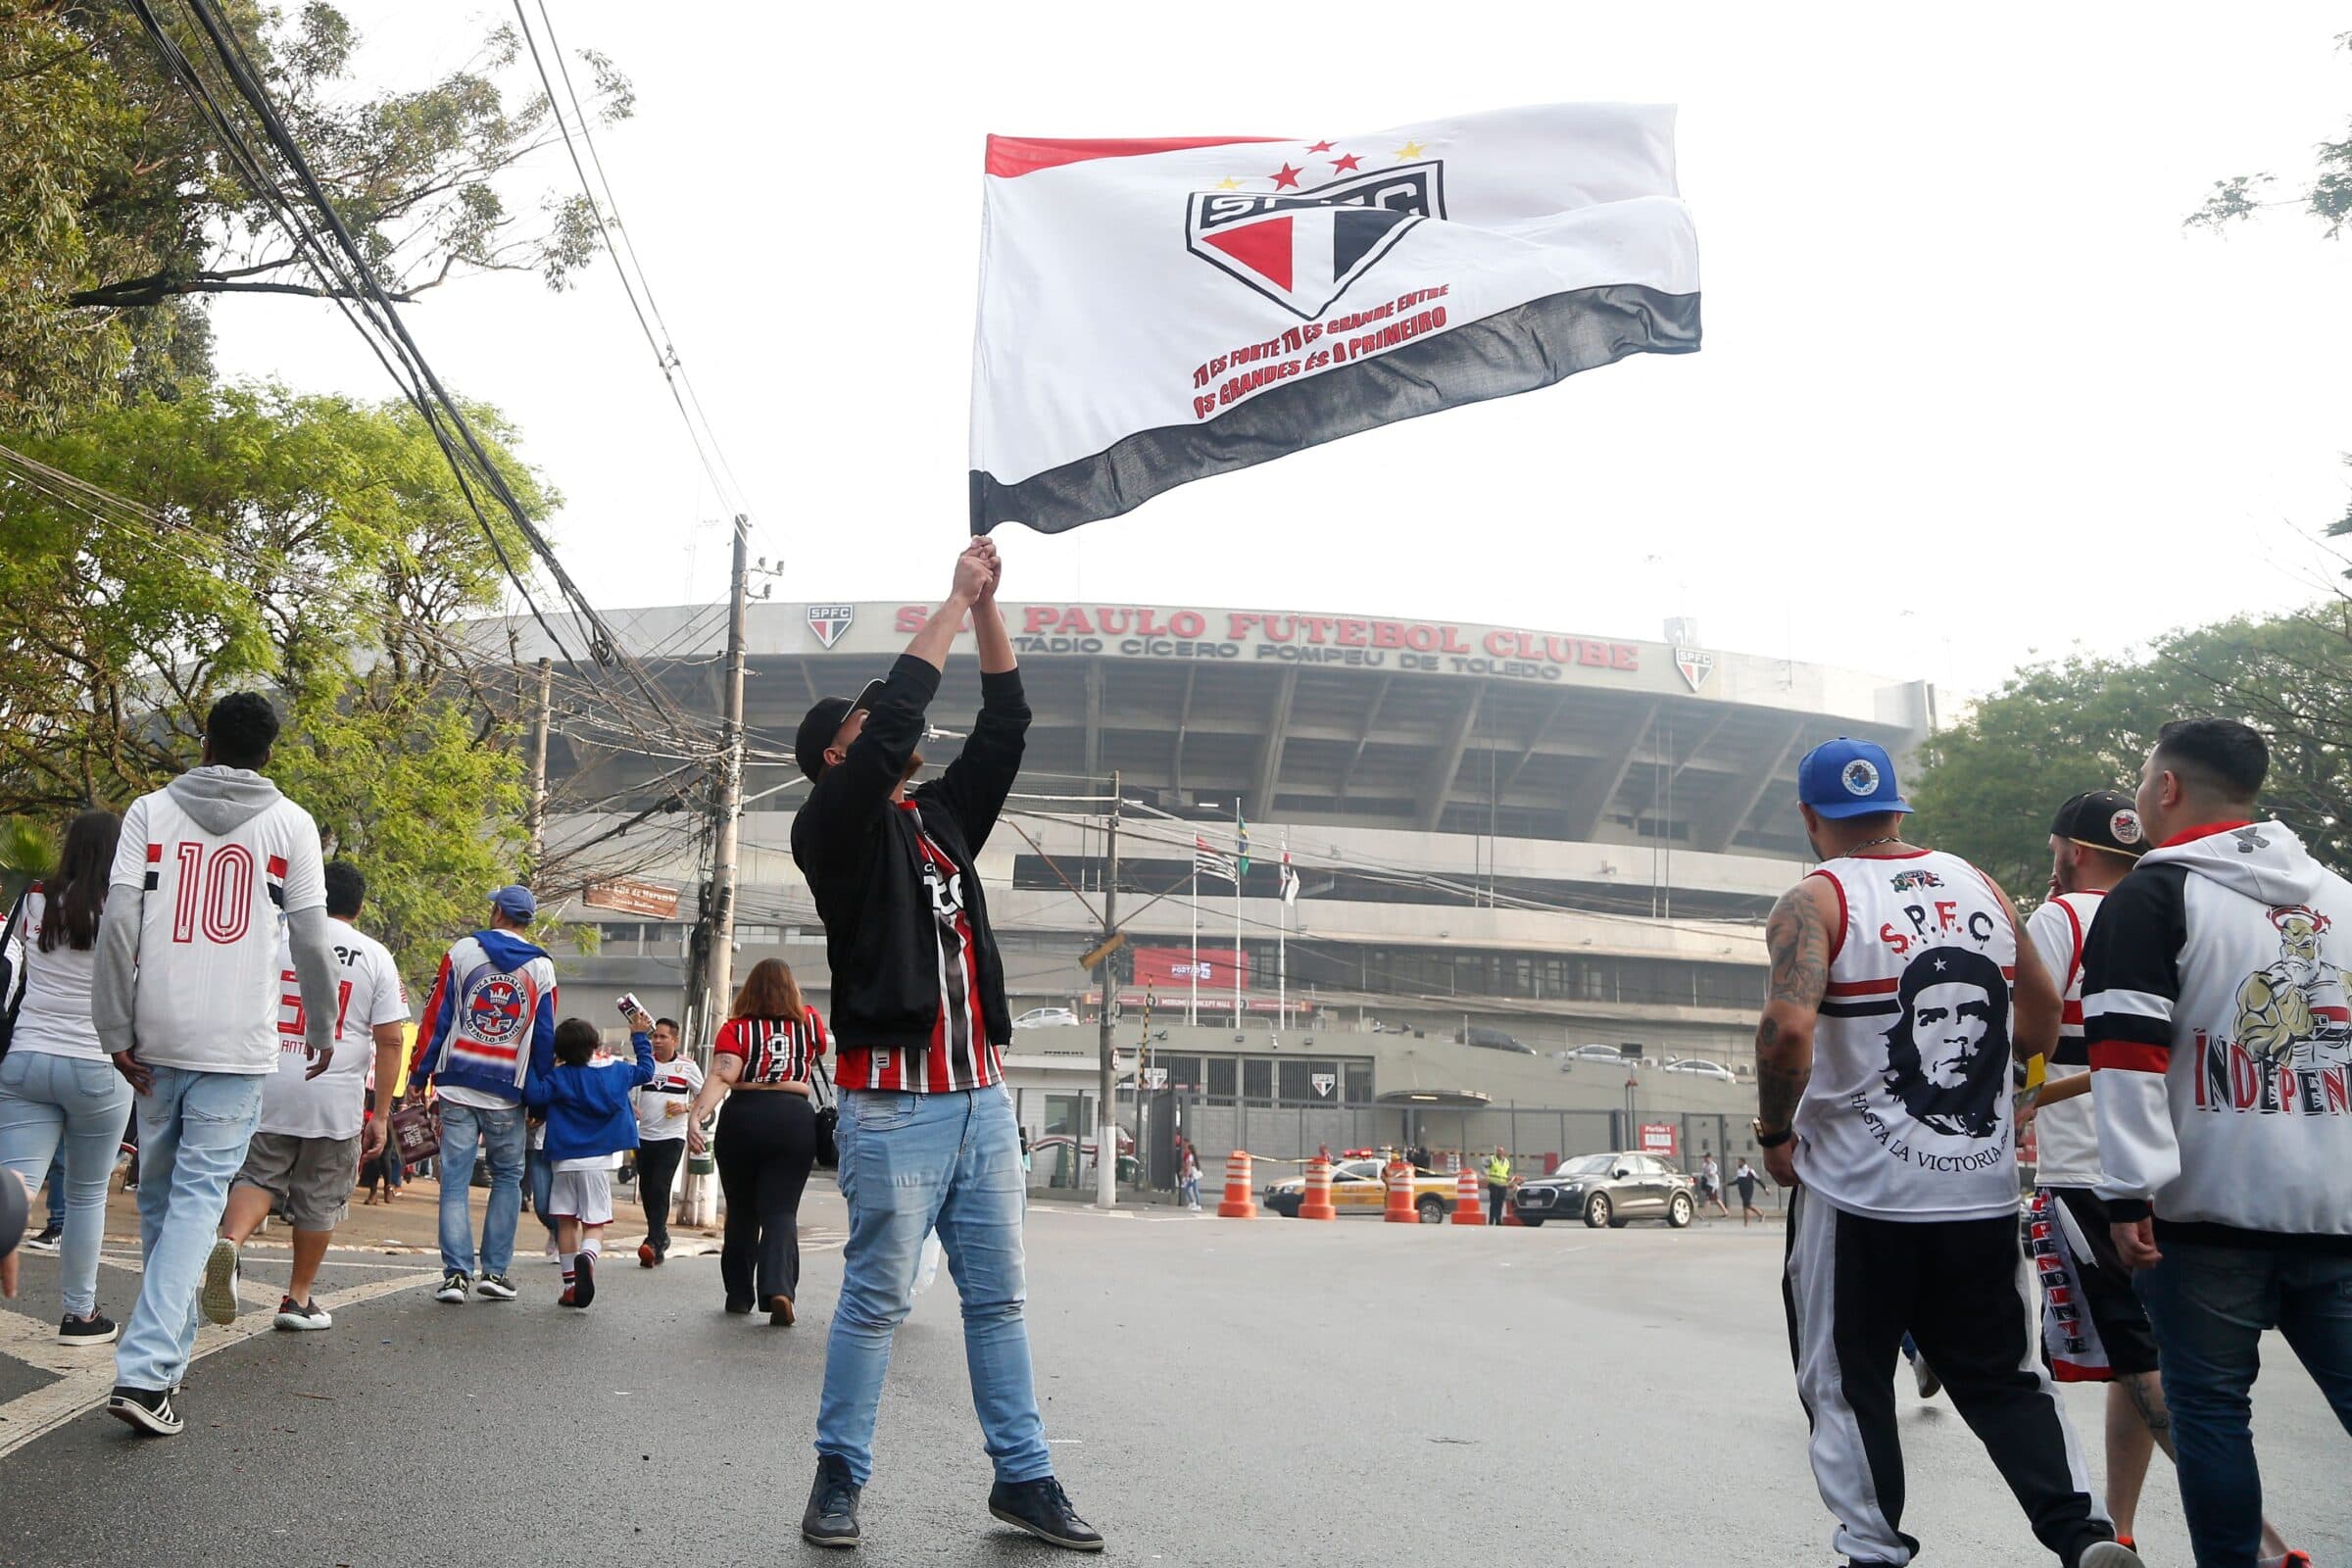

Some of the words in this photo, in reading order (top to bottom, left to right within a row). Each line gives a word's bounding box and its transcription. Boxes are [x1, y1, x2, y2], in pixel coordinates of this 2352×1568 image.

[1219, 360, 1300, 405] GRANDES
[1348, 306, 1446, 360] PRIMEIRO
[1230, 338, 1280, 366] FORTE
[1281, 325, 1301, 352] TU
[1326, 302, 1395, 335] GRANDE
[1396, 283, 1449, 314] ENTRE
[809, 607, 851, 619] SPFC
[1022, 606, 1206, 639] PAULO
[1227, 612, 1470, 655] FUTEBOL
[1484, 627, 1639, 671] CLUBE
[1120, 635, 1240, 659] CÍCERO
[1255, 643, 1385, 666] POMPEU
[1398, 652, 1440, 671] DE
[1450, 656, 1562, 681] TOLEDO
[1679, 650, 1711, 665] SPFC
[173, 841, 254, 944] 10
[1200, 962, 1211, 979] 5
[2193, 1028, 2352, 1115] INDEPEN
[1850, 1091, 1891, 1145] HASTA
[1888, 1140, 1910, 1162] LA
[1917, 1146, 2002, 1172] VICTORIA
